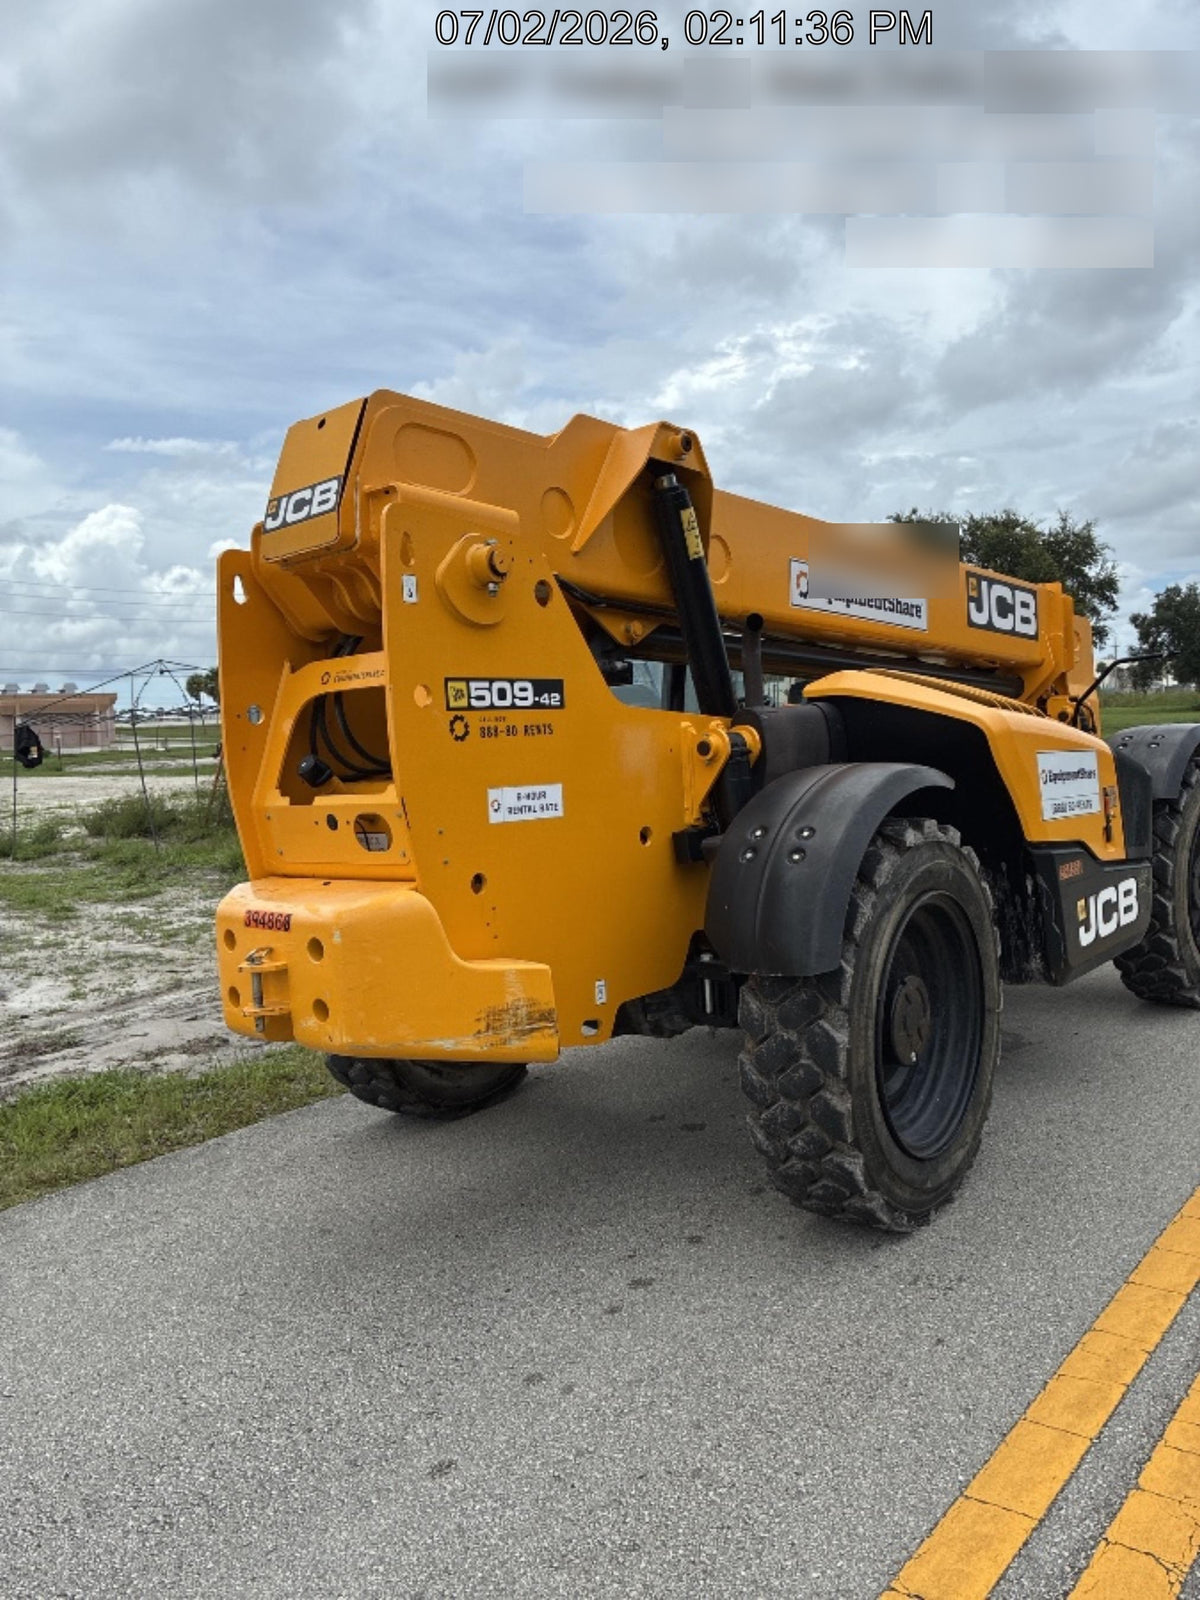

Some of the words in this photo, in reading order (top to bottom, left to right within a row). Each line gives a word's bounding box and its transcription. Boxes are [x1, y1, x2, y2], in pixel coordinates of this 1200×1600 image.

[265, 479, 339, 531] JCB
[969, 581, 1037, 636] JCB
[524, 723, 554, 737] RENTS
[507, 804, 538, 815] RENTAL
[1079, 878, 1139, 947] JCB
